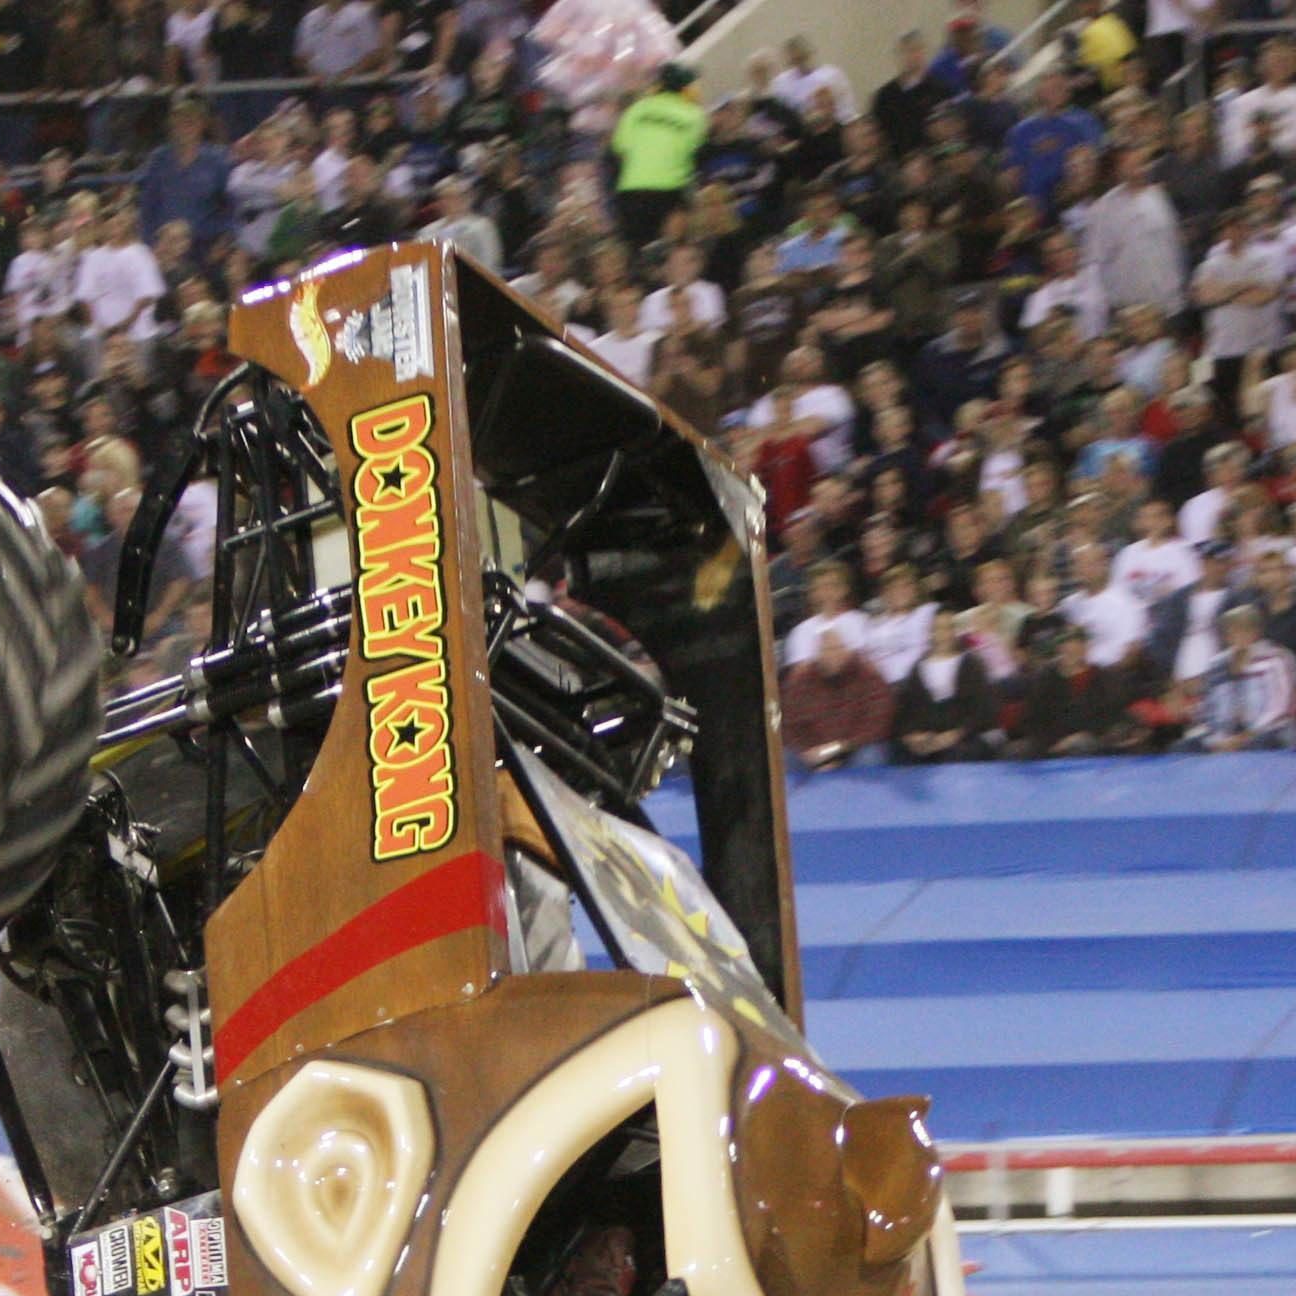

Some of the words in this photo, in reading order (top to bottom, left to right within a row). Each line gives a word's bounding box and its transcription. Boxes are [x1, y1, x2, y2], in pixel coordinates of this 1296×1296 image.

[351, 394, 444, 662] DONKEY
[368, 659, 457, 861] KONG
[109, 1228, 130, 1290] CROWER
[167, 1210, 190, 1295] ARP
